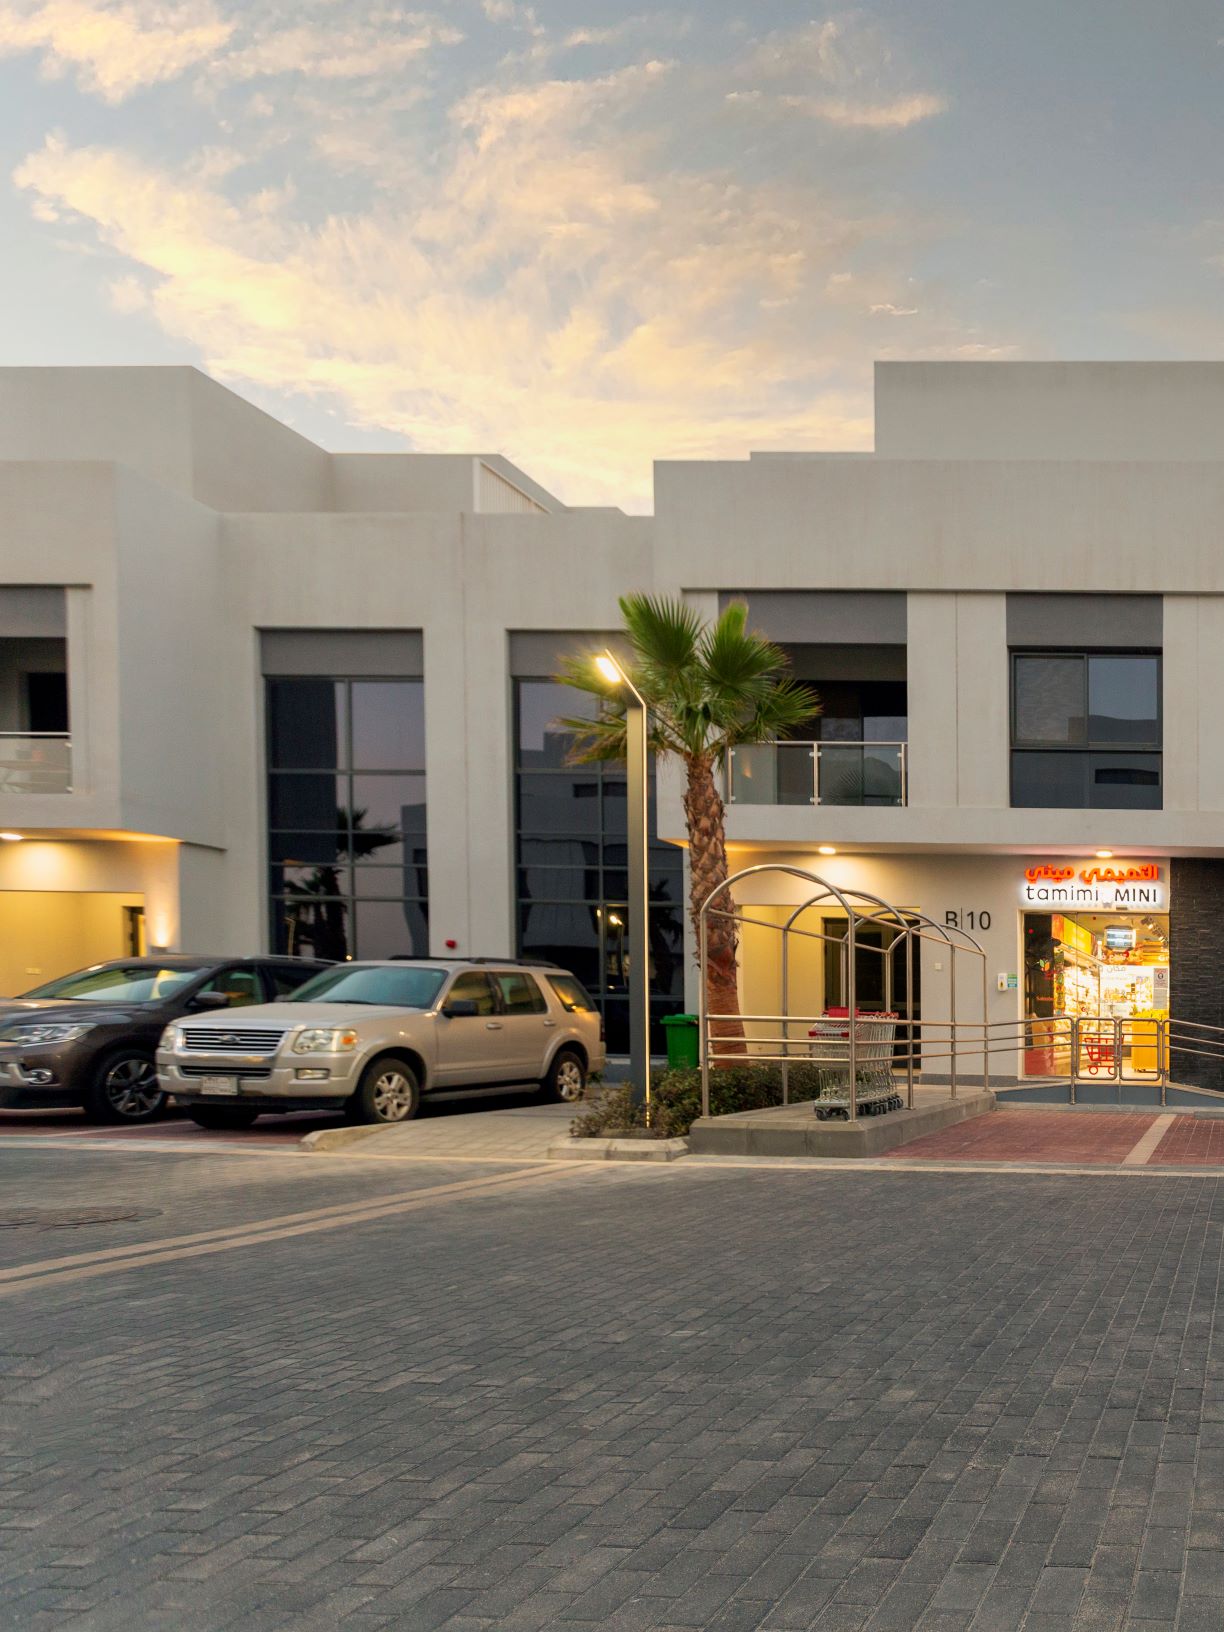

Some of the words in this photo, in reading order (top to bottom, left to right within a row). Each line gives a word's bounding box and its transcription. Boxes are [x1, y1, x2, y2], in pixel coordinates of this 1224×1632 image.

[1025, 863, 1075, 884] ميني
[1080, 863, 1158, 884] التميمي
[1026, 885, 1099, 901] tamimi
[1114, 888, 1157, 902] MINI
